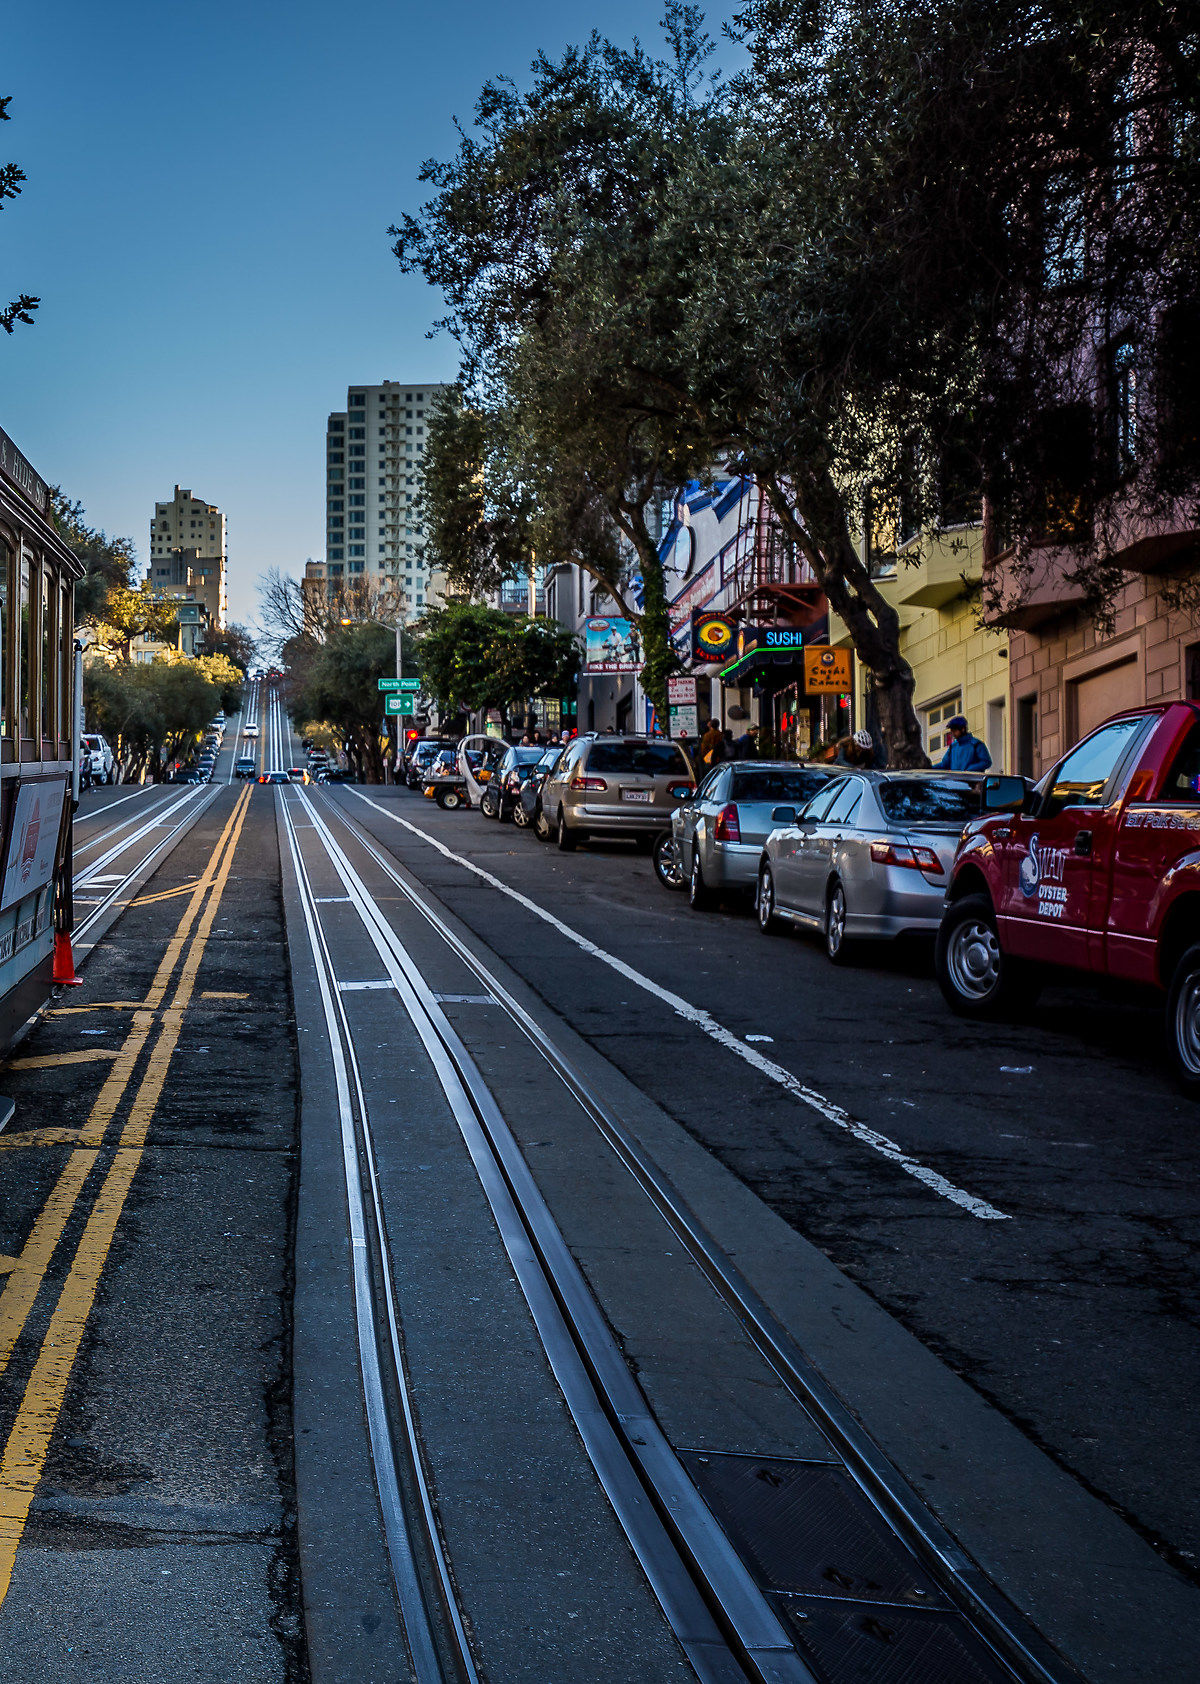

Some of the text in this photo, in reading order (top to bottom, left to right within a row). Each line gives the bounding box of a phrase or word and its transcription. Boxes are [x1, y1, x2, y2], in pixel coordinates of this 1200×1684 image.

[12, 452, 34, 494] HYDE
[766, 631, 802, 646] SUSHI
[811, 666, 846, 675] Sushi
[809, 677, 848, 686] Ramen
[1144, 812, 1170, 829] Polk
[1170, 813, 1200, 831] Stree
[1038, 884, 1067, 902] OYSTER
[1038, 901, 1064, 918] DEPOT
